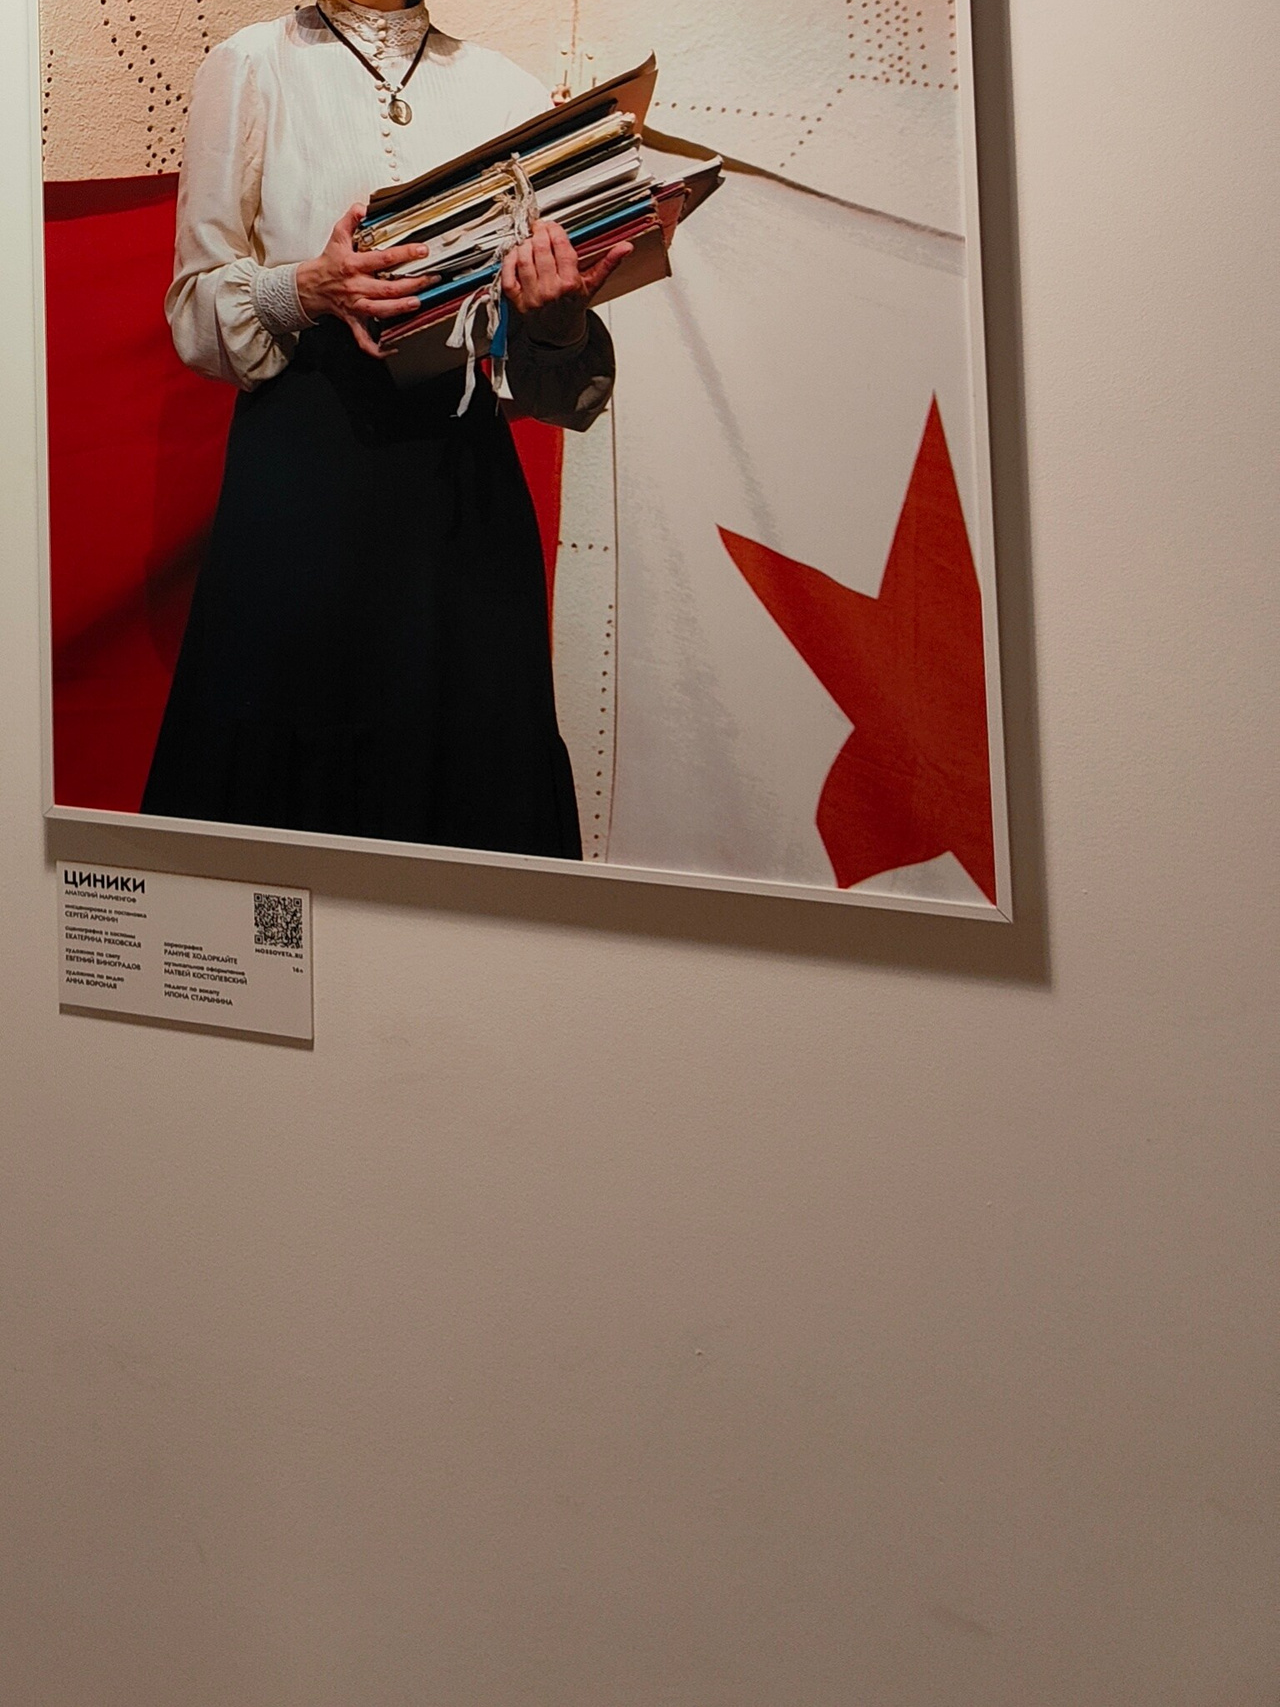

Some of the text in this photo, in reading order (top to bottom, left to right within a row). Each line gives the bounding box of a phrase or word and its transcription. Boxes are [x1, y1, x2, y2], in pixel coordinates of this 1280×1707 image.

[64, 870, 145, 894] ЦИНИКИ
[65, 911, 89, 919] СЕРГЕЙ
[65, 932, 102, 943] ЕКАТЕРИНА
[96, 958, 141, 971] ВИНОГРАДОВ
[164, 968, 191, 977] МАТВЕЙ
